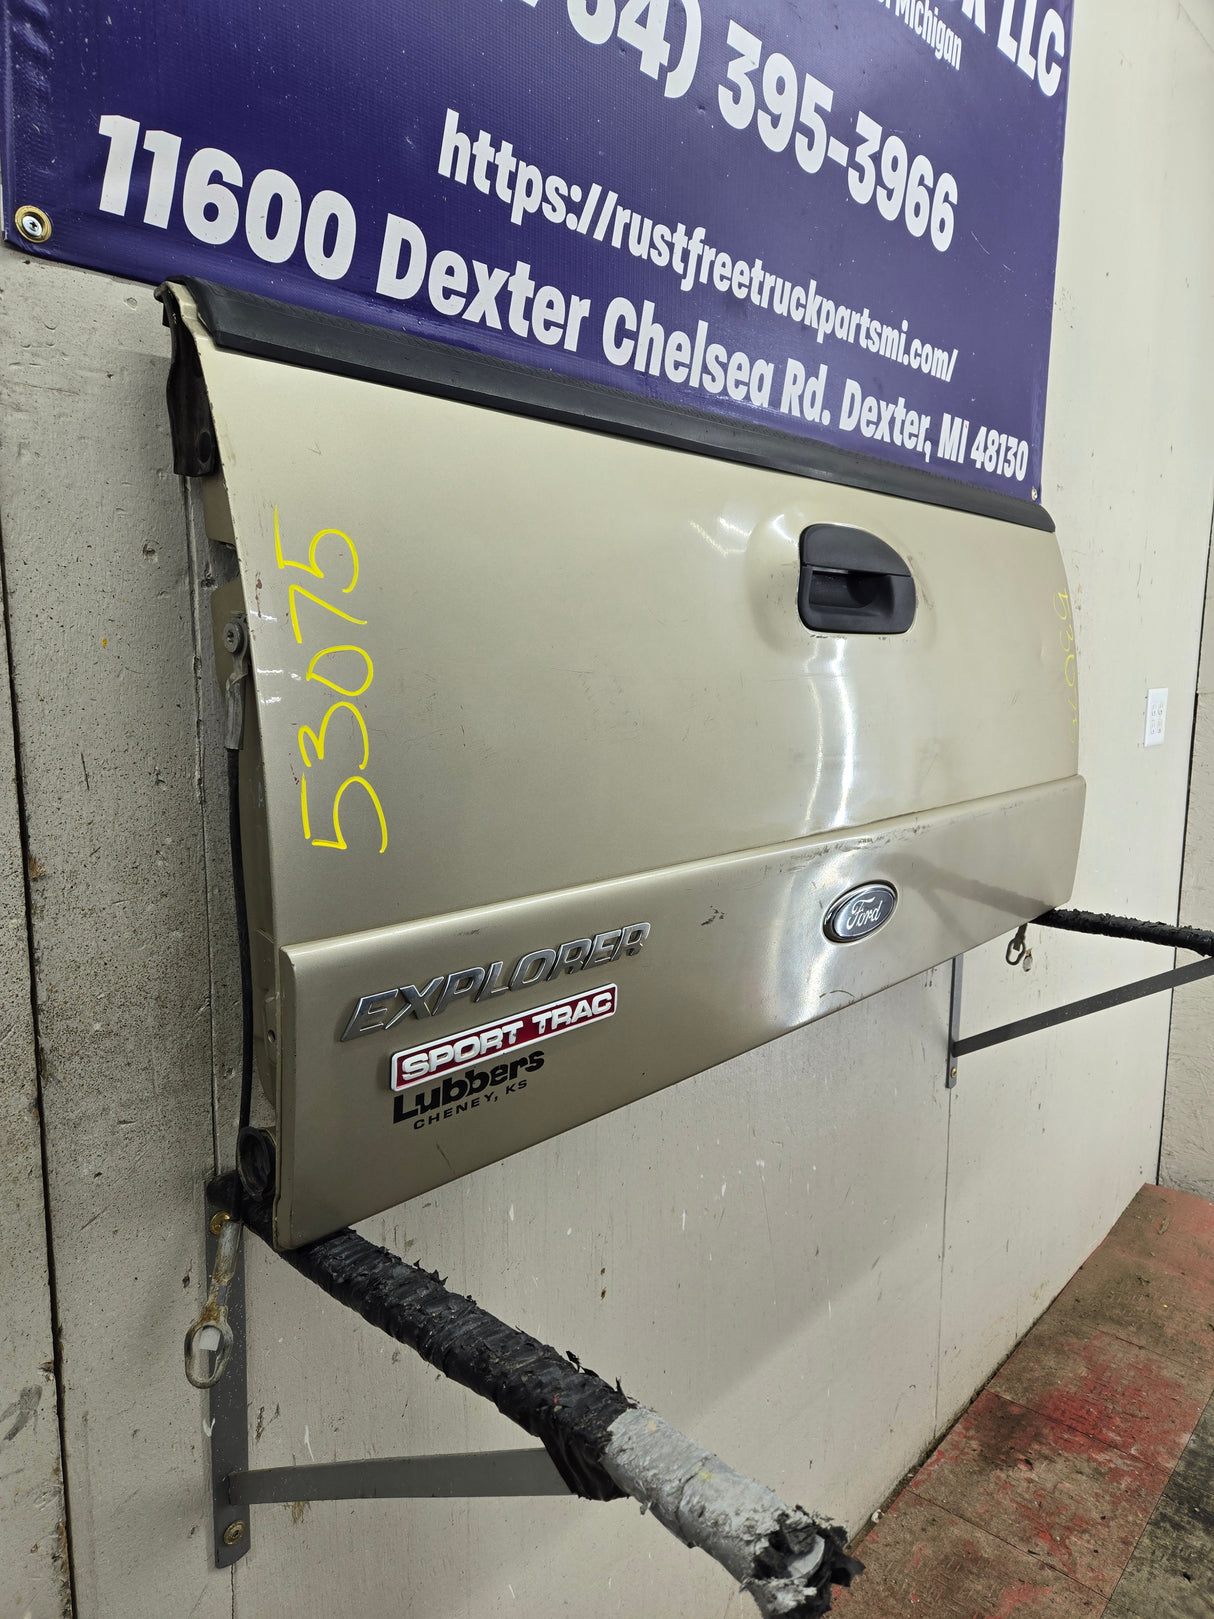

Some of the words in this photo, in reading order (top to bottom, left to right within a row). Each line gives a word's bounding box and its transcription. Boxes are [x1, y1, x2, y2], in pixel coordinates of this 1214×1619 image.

[997, 0, 1065, 97] LLC
[718, 20, 958, 252] 395-3966
[98, 114, 357, 281] 11600
[376, 213, 591, 352] Dexter
[602, 297, 775, 407] Chelsea
[780, 357, 831, 426] Rd.
[839, 379, 931, 462] Dexter,
[937, 413, 969, 464] MI
[970, 423, 1029, 481] 48130
[438, 108, 958, 382] https://rustfreetruckpartsmi.com/
[273, 504, 388, 854] 53075
[846, 896, 883, 930] Ford
[340, 921, 651, 1042] EXPLORER
[392, 1050, 545, 1124] Lubbers
[402, 1020, 524, 1081] SPORT
[532, 992, 613, 1034] TRAC
[413, 1090, 499, 1131] CHENEY,
[506, 1079, 528, 1094] KS
